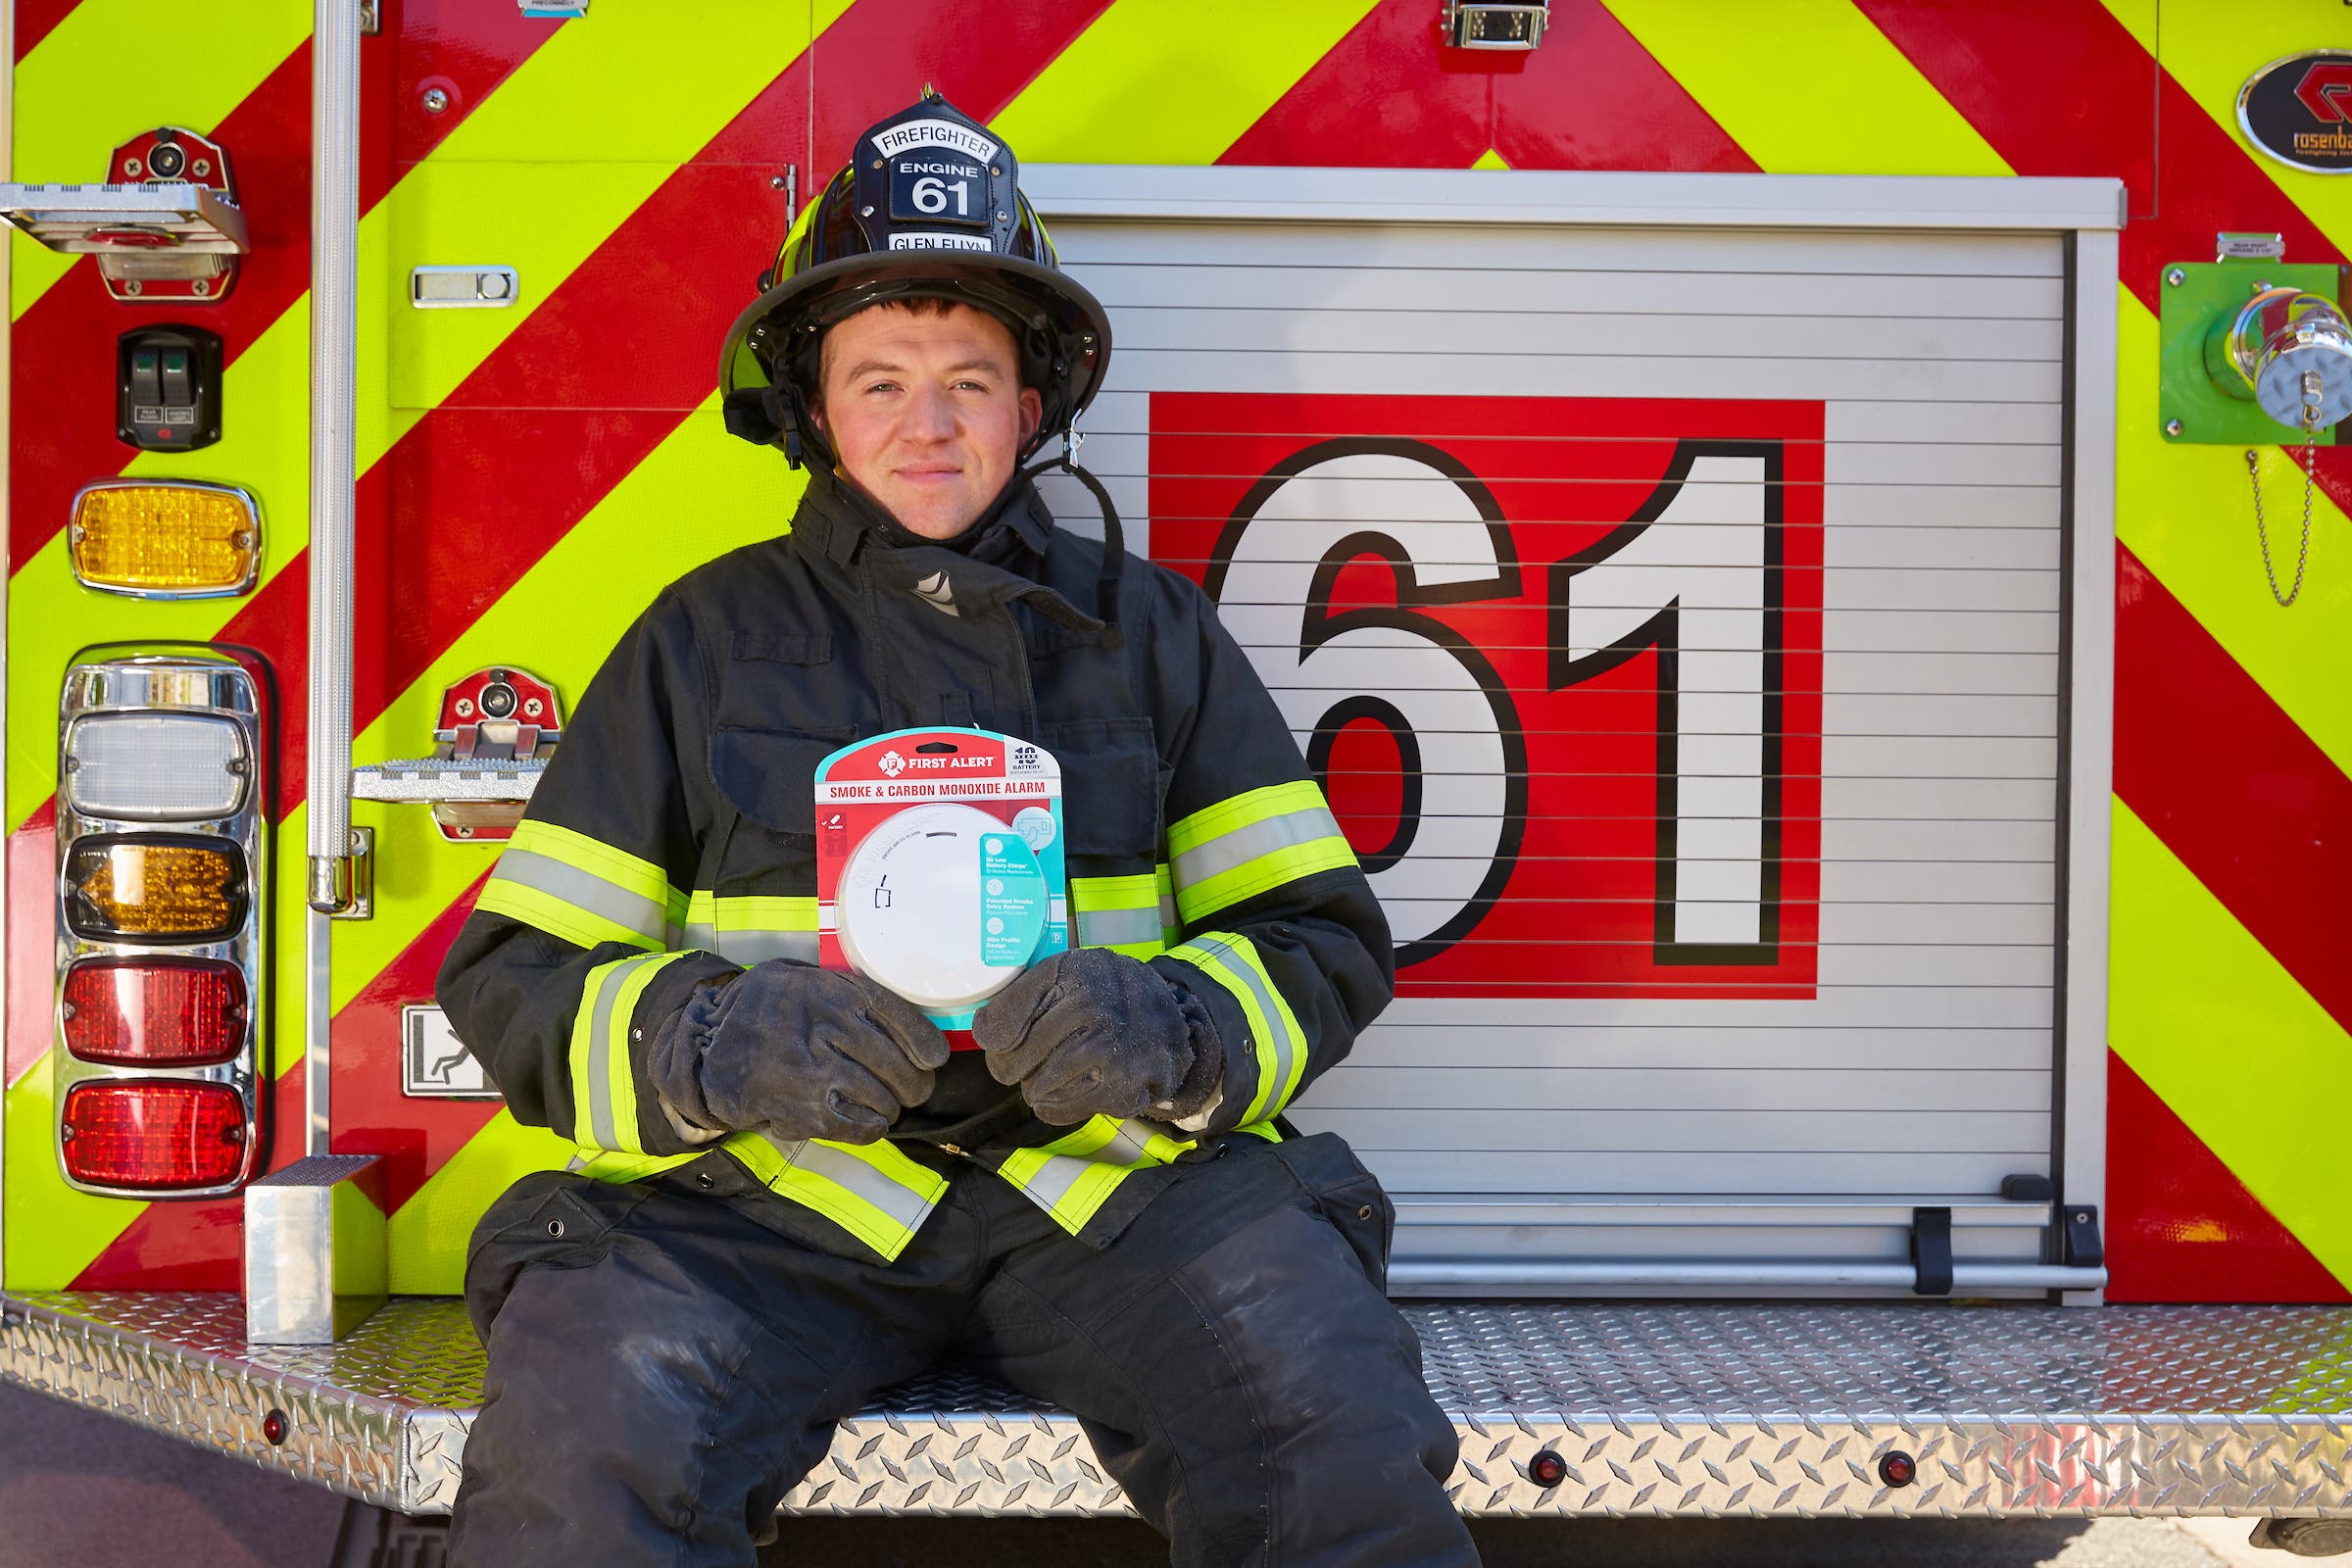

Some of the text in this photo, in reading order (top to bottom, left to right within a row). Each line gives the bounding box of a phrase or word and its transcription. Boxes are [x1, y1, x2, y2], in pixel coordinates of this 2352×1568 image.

[882, 126, 990, 157] FIREFIGHTER
[900, 163, 978, 178] ENGINE
[911, 176, 968, 217] 61
[894, 238, 935, 251] GLEN
[1200, 435, 1784, 969] 61
[908, 758, 947, 769] FIRST
[951, 757, 994, 768] ALERT
[830, 781, 1046, 799] SMOKE & CARBON MONOXIDE ALARM
